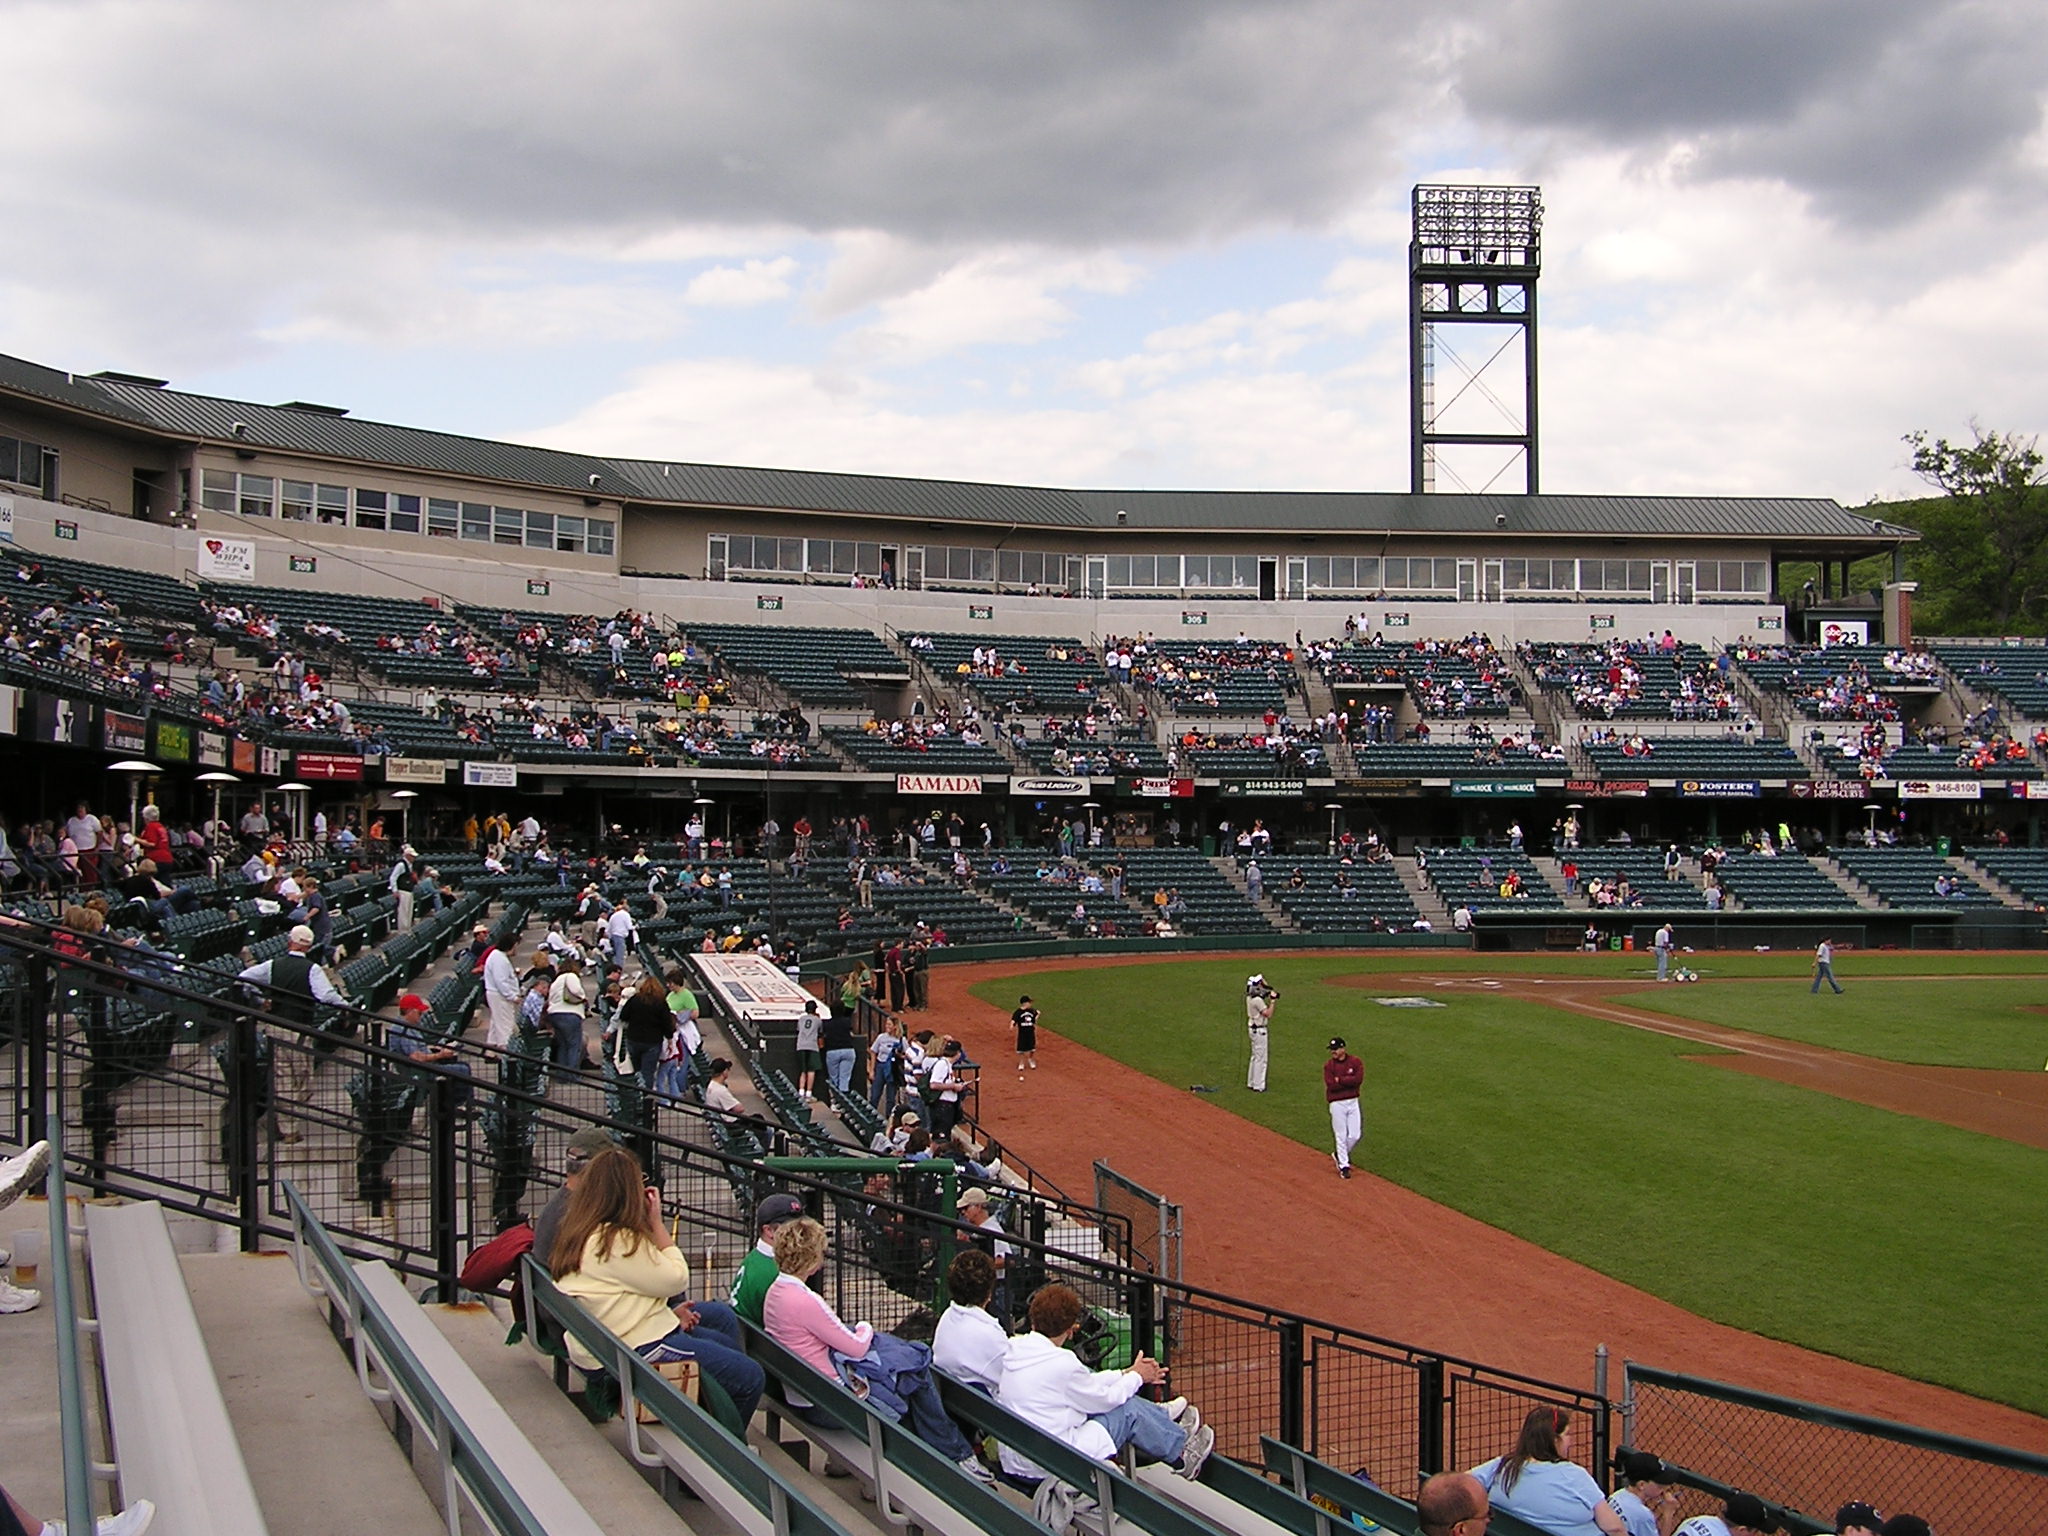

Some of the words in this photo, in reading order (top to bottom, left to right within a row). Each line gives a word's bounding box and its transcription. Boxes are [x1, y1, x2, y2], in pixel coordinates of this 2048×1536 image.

[60, 527, 74, 539] 310
[295, 561, 312, 572] 309
[762, 600, 778, 609] 307
[1594, 619, 1609, 627] 303
[1762, 620, 1777, 628] 302
[1841, 632, 1859, 646] 23
[900, 776, 980, 791] RAMADA
[1245, 781, 1303, 789] 814-943-5400
[1567, 781, 1595, 790] KELLER
[1815, 781, 1827, 789] Call
[1839, 781, 1862, 789] Tickets
[1935, 783, 1977, 792] 946-8100
[804, 1019, 812, 1029] 8
